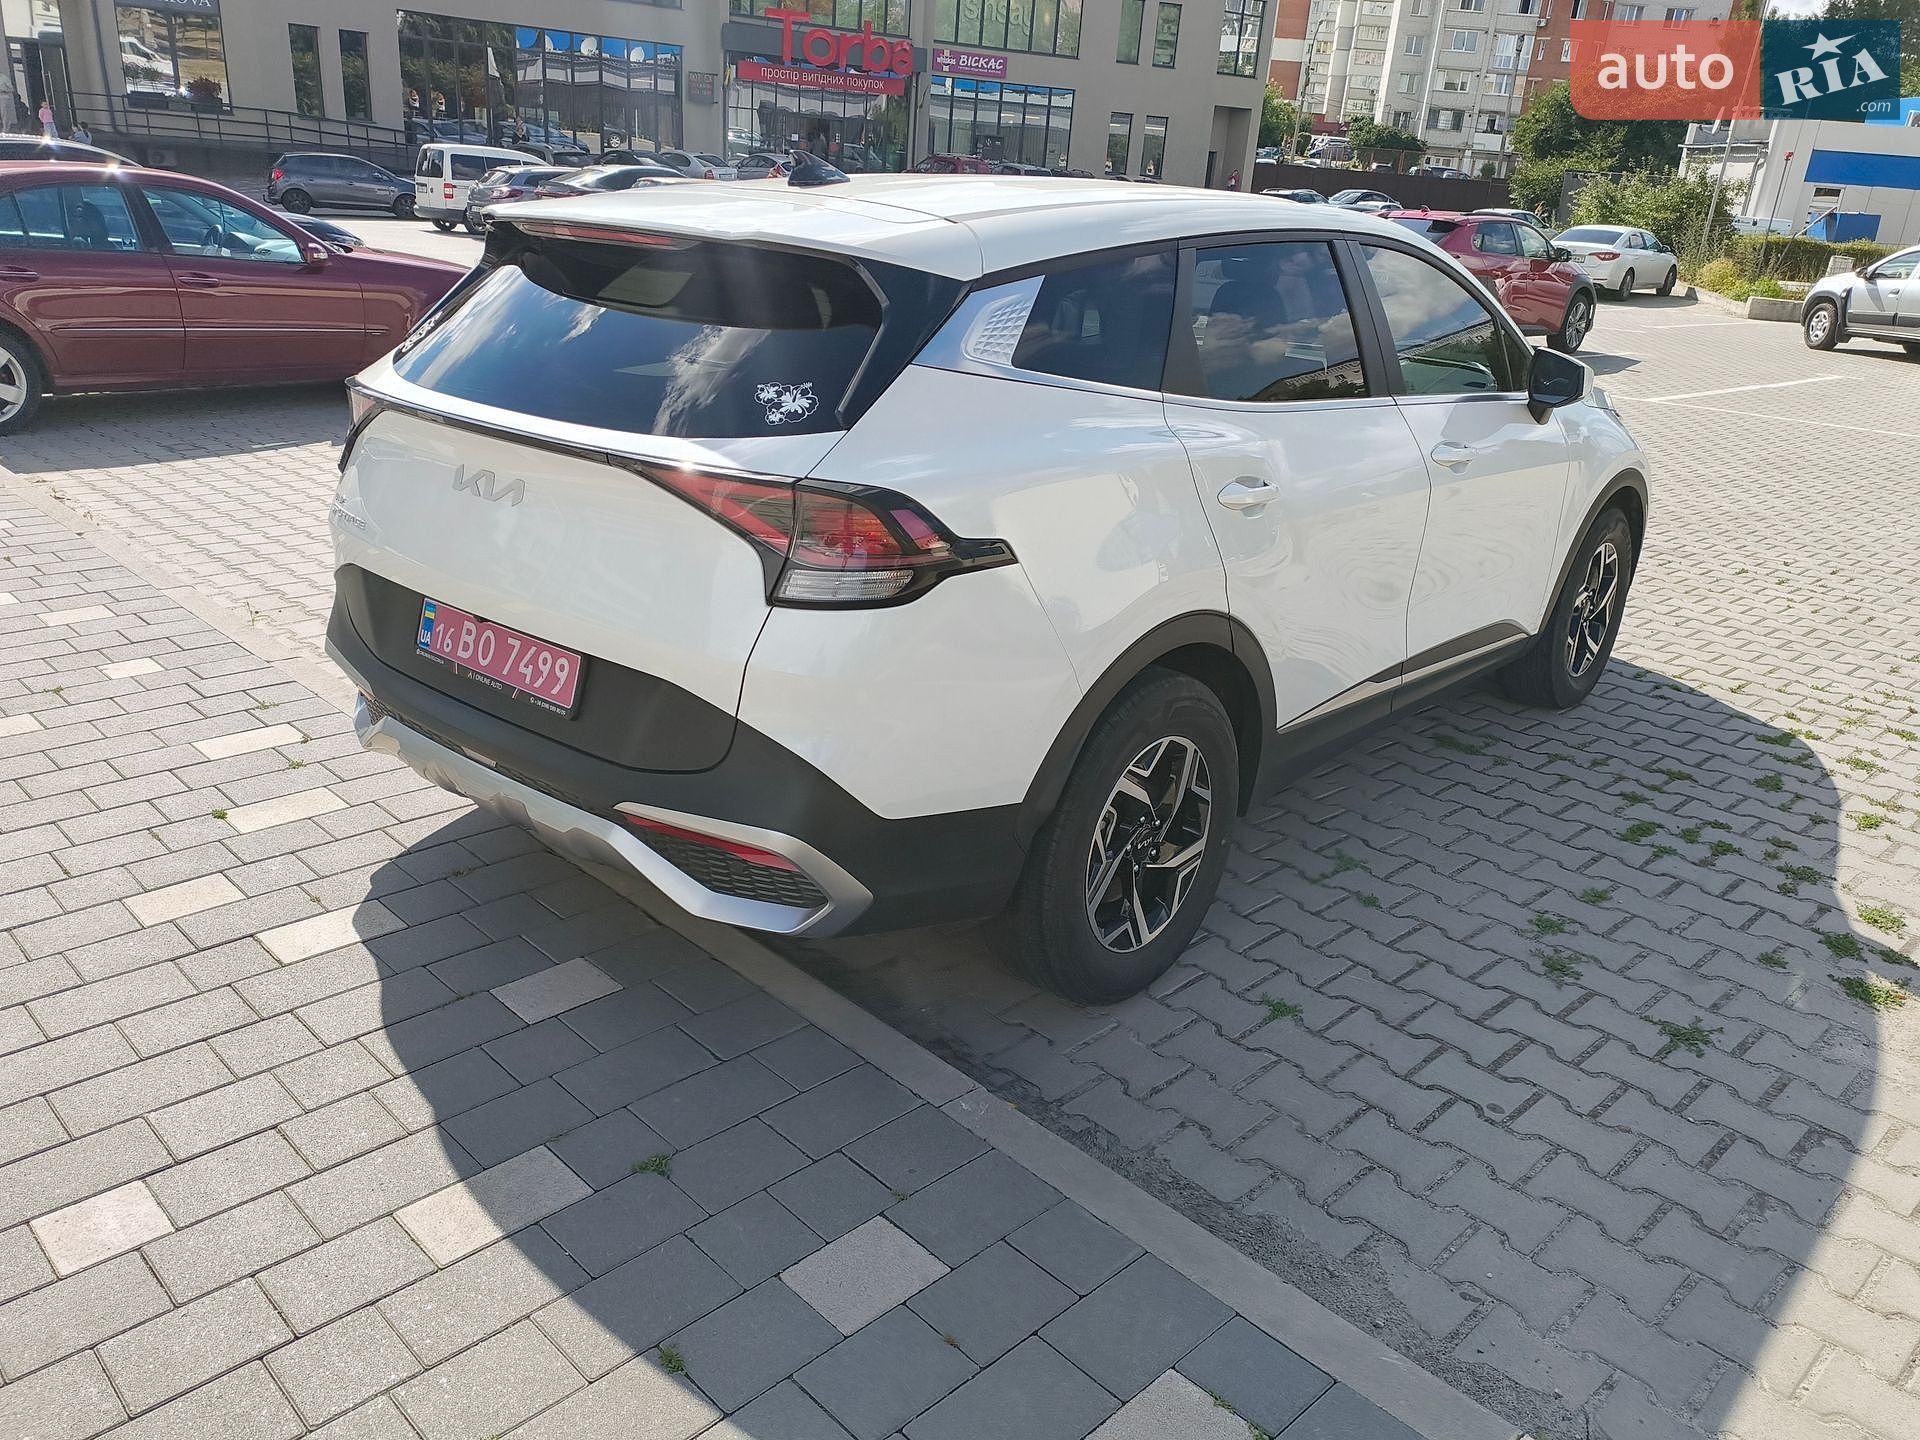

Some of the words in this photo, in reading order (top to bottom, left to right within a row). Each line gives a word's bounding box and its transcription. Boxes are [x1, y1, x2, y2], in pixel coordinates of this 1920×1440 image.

[764, 7, 914, 78] Torba
[959, 54, 1004, 70] ВІСКАС
[761, 66, 800, 82] простір
[802, 71, 844, 86] вигідних
[846, 76, 885, 90] покупок
[420, 629, 431, 645] UA
[436, 623, 455, 653] 16
[502, 637, 570, 695] 7499
